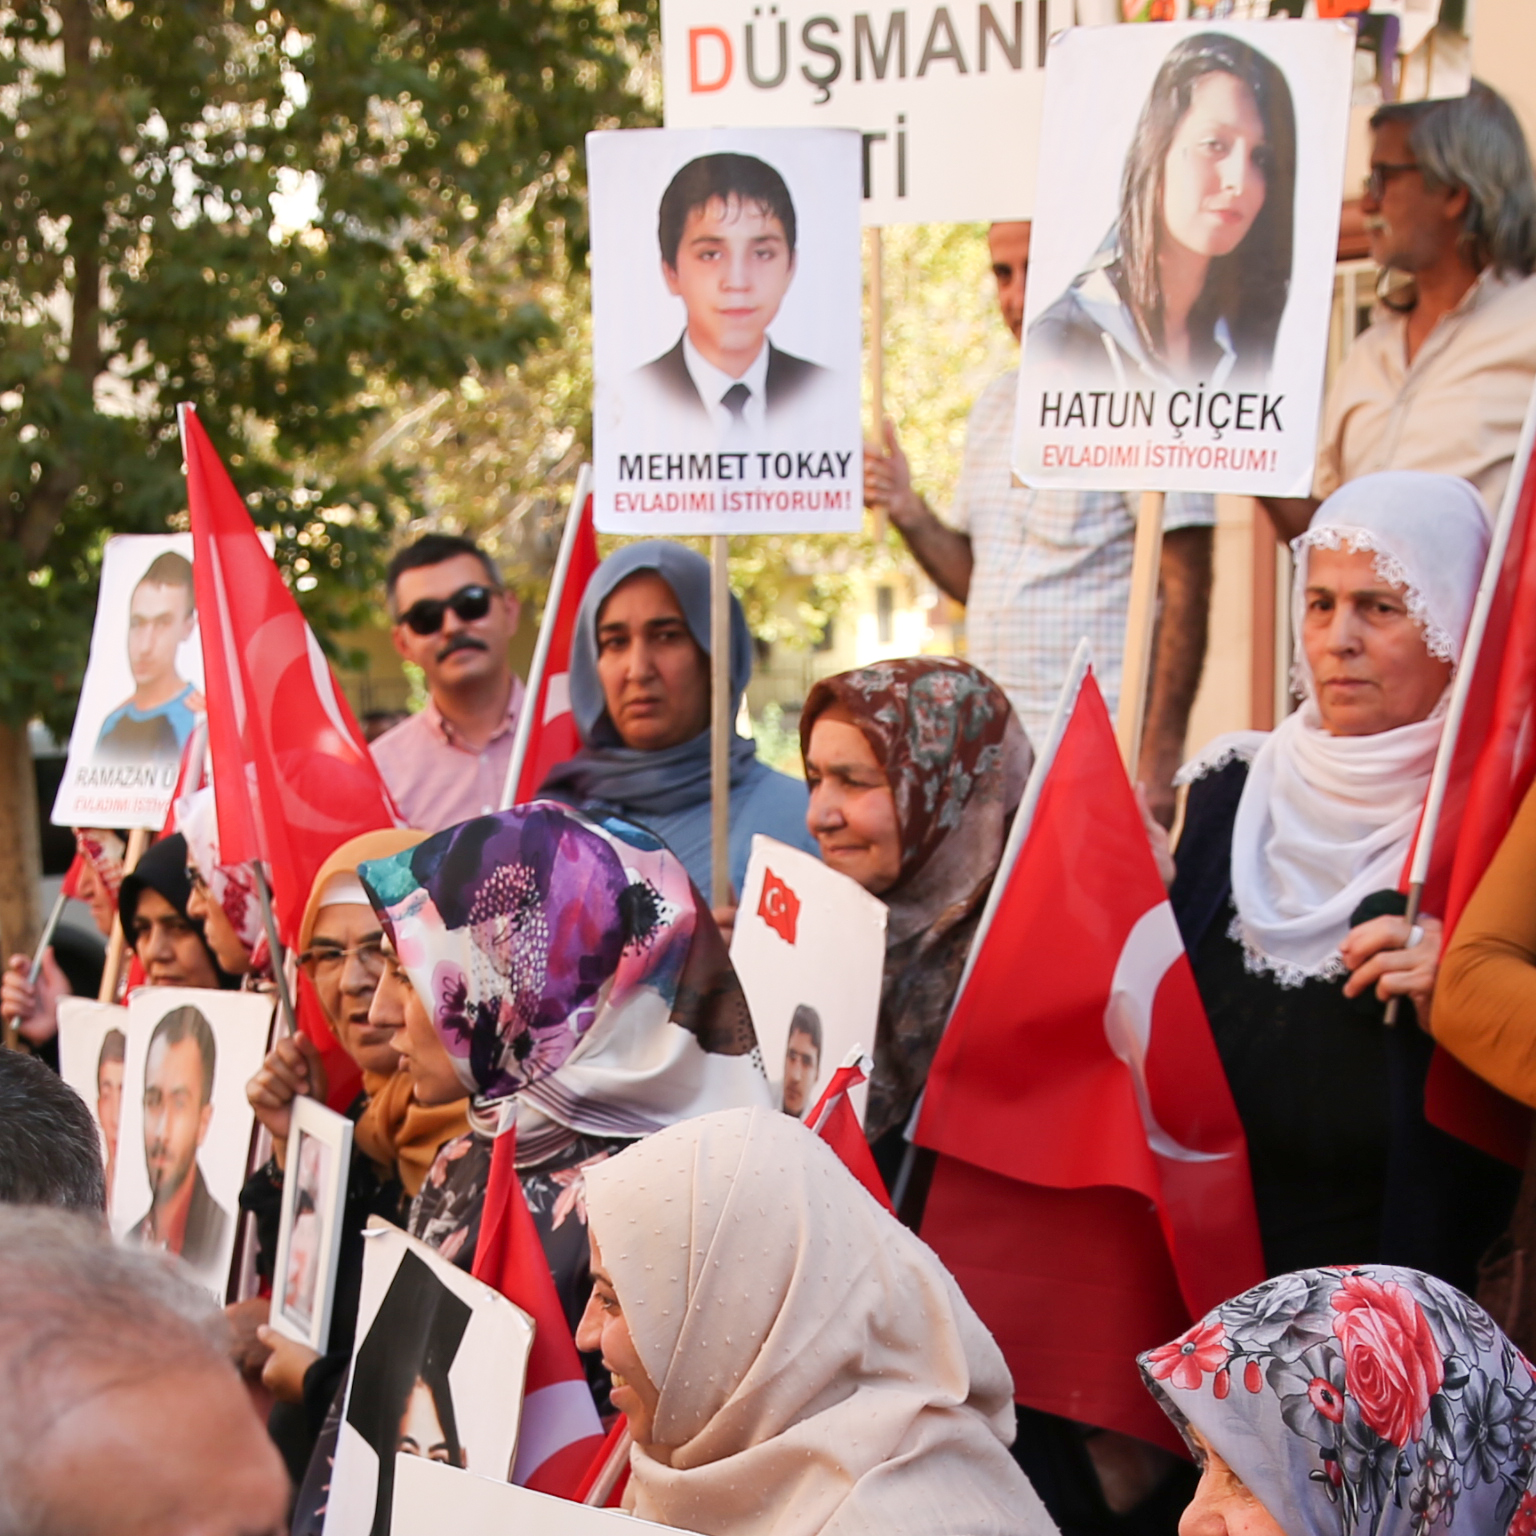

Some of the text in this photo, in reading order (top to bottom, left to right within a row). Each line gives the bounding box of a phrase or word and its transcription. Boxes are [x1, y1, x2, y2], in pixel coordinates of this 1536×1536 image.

[1040, 382, 1285, 440] HATUN ÇİÇEK
[619, 451, 852, 481] MEHMET TOKAY
[1042, 440, 1277, 472] EVLADIMI İSTİYORUM!
[615, 486, 851, 512] EVLADIMI İSTİYORUM!
[74, 765, 156, 788] RAMAZAN
